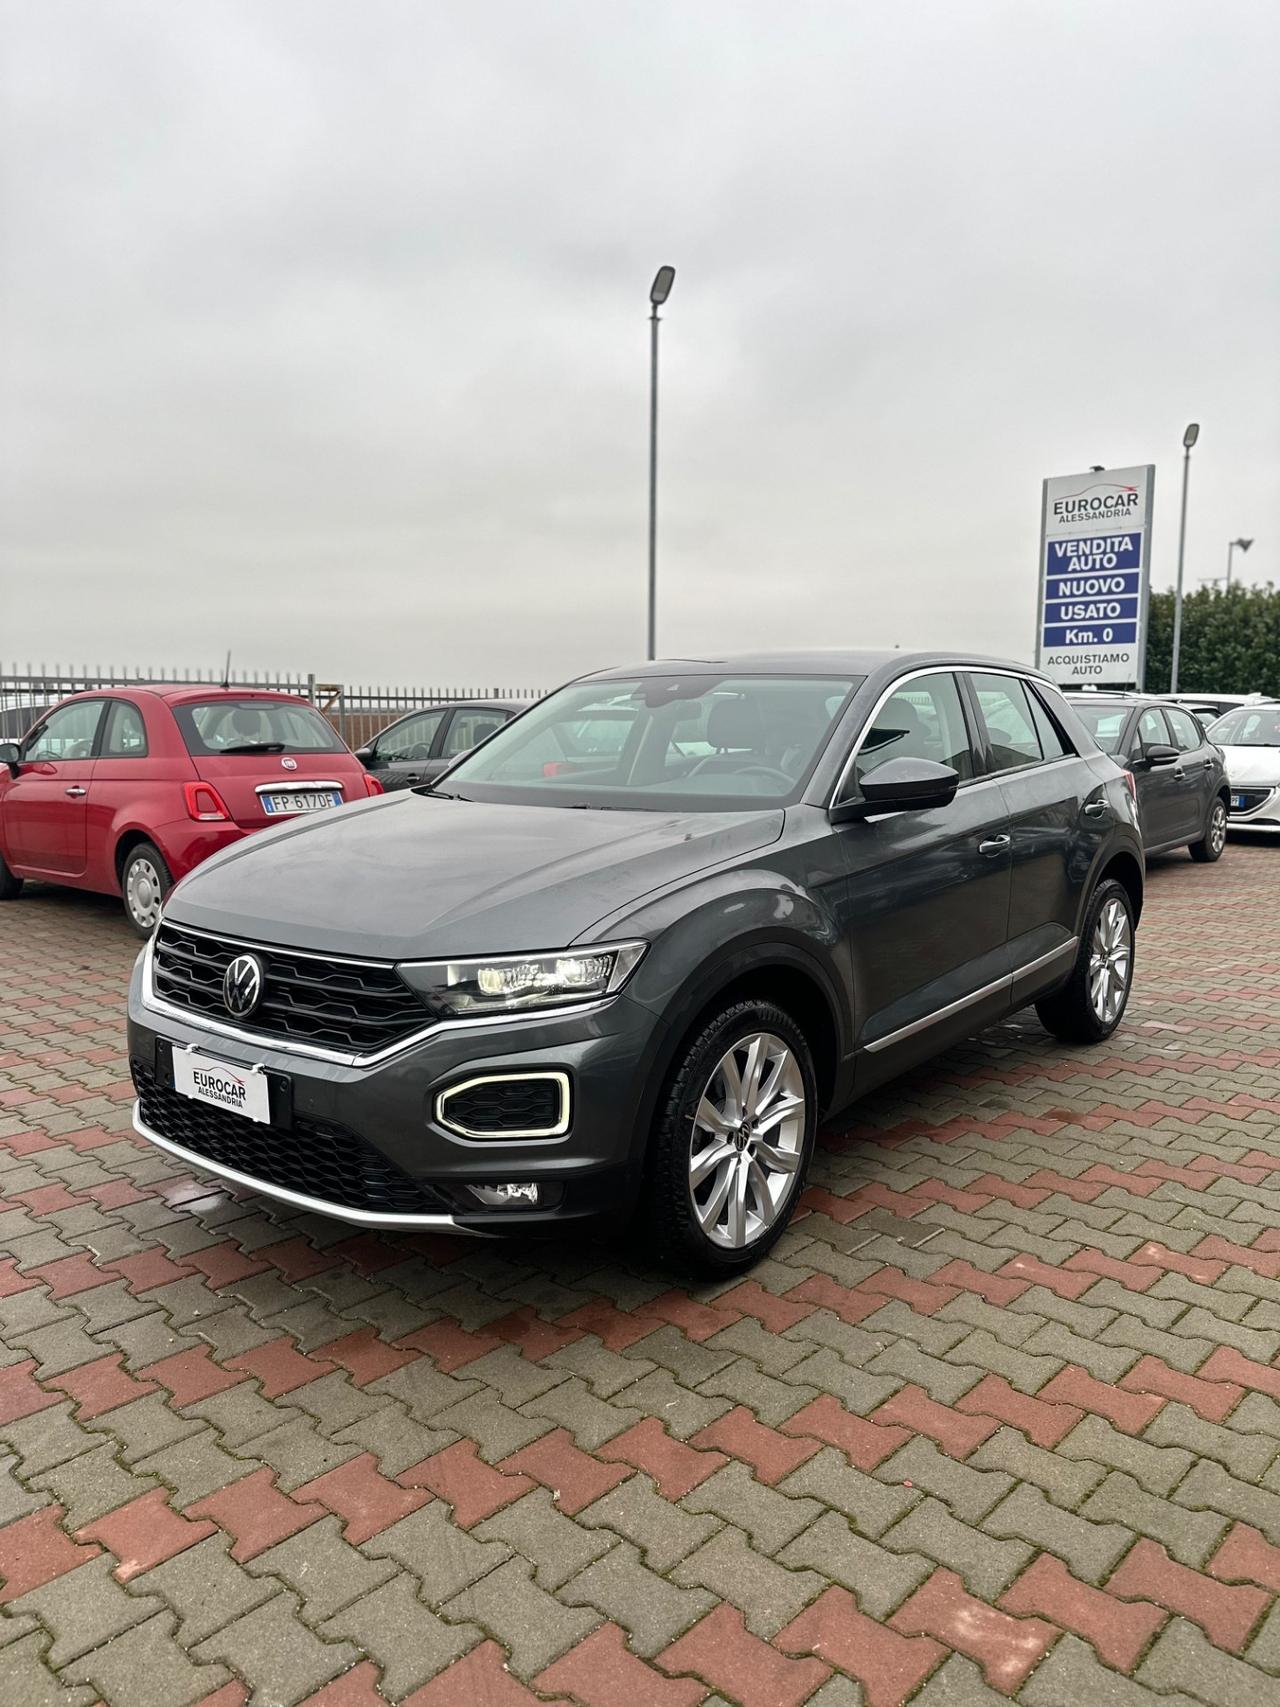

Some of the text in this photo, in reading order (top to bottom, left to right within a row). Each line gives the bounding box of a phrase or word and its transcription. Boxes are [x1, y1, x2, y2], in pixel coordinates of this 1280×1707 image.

[1053, 493, 1139, 515] EUROCAR
[1059, 508, 1131, 524] ALESSANDRIA
[1054, 536, 1134, 558] VENDITA
[1067, 553, 1117, 572] AUTO
[1058, 577, 1125, 597] NUOVO
[1060, 602, 1121, 620] USATO
[1065, 627, 1113, 644] Km. 0
[1047, 653, 1130, 666] ACQUISTIAMO
[1072, 665, 1103, 675] AUTO
[193, 1071, 247, 1101] EUROCAR
[198, 1086, 244, 1108] ALESSANDRIA
